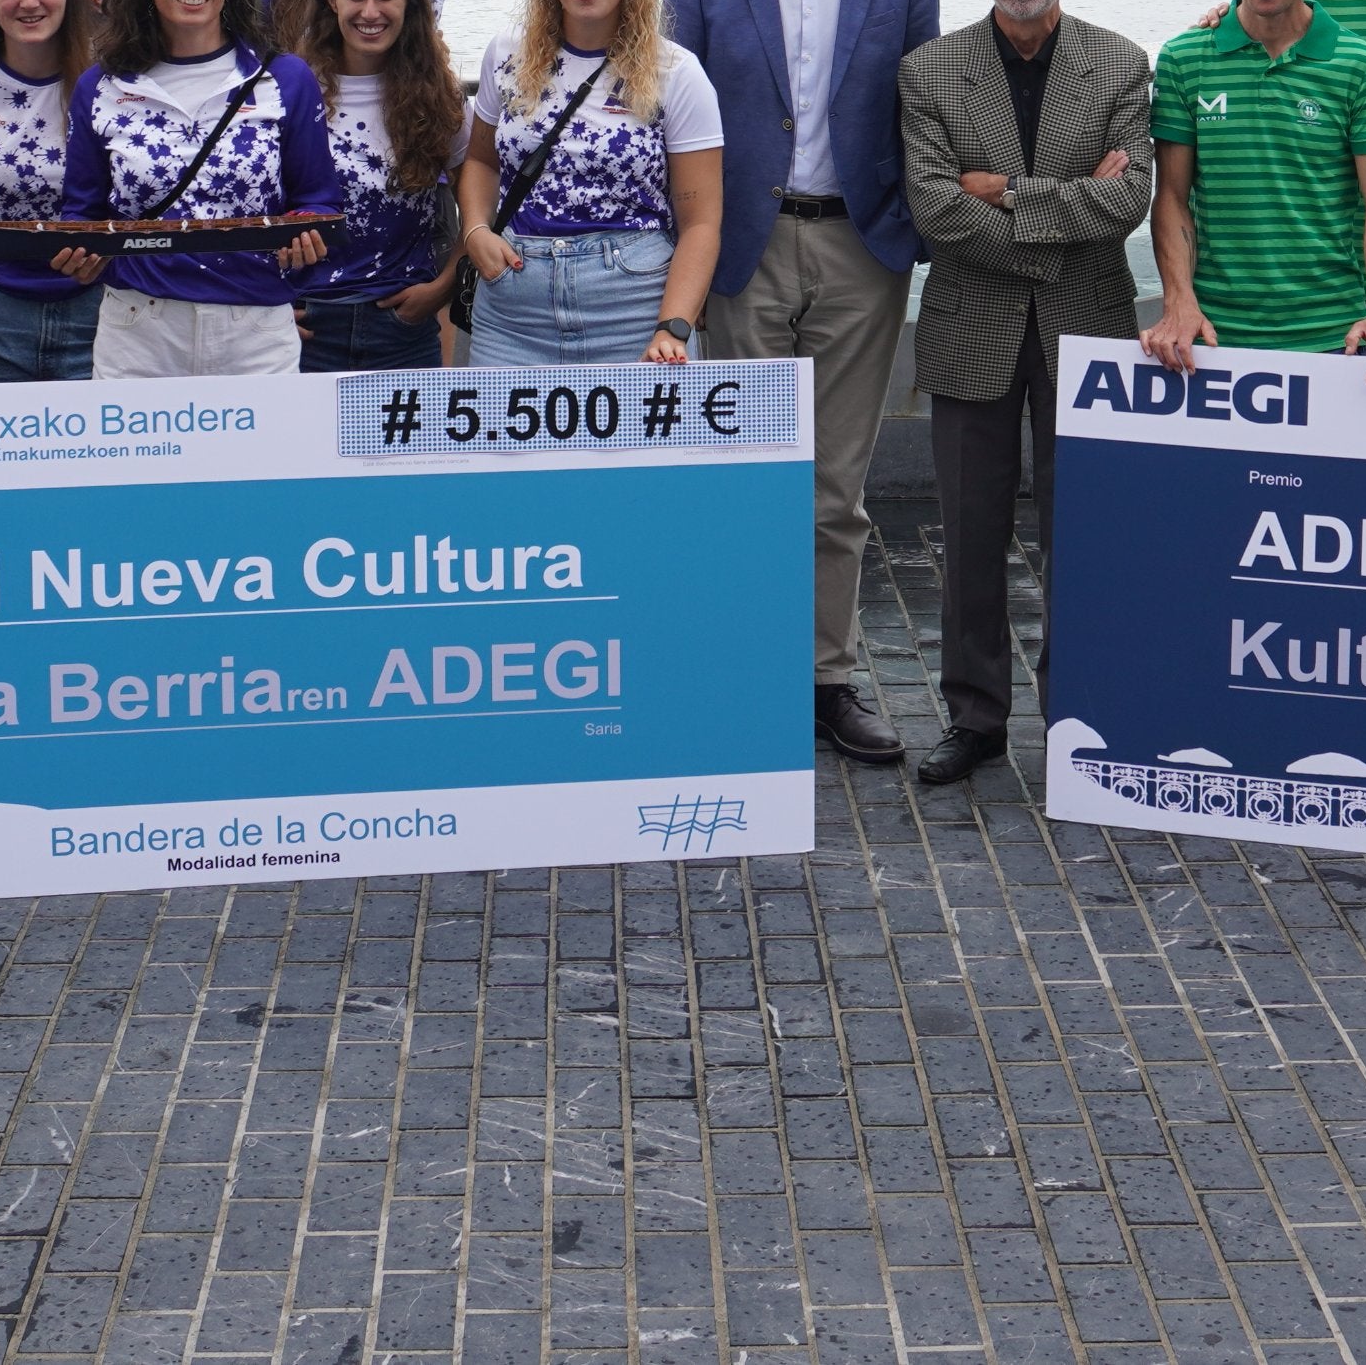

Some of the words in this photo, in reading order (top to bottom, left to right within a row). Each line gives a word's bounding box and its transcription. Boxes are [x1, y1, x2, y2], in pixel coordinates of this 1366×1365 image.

[123, 238, 172, 249] ADEGI
[1072, 359, 1310, 426] ADEGI
[101, 402, 256, 435] Bandera
[445, 386, 620, 441] 5.500
[701, 382, 741, 436] €
[135, 442, 182, 456] maila
[1248, 470, 1303, 488] Premio
[32, 548, 275, 610] Nueva
[303, 535, 584, 599] Cultura
[48, 656, 348, 724] Berriaren
[369, 639, 622, 708] ADEGI
[584, 722, 622, 736] Saria
[51, 820, 205, 857] Bandera
[219, 816, 263, 848] de
[276, 815, 307, 844] la
[319, 808, 458, 842] Concha
[167, 852, 257, 872] Modalidad
[261, 850, 341, 868] femenina
